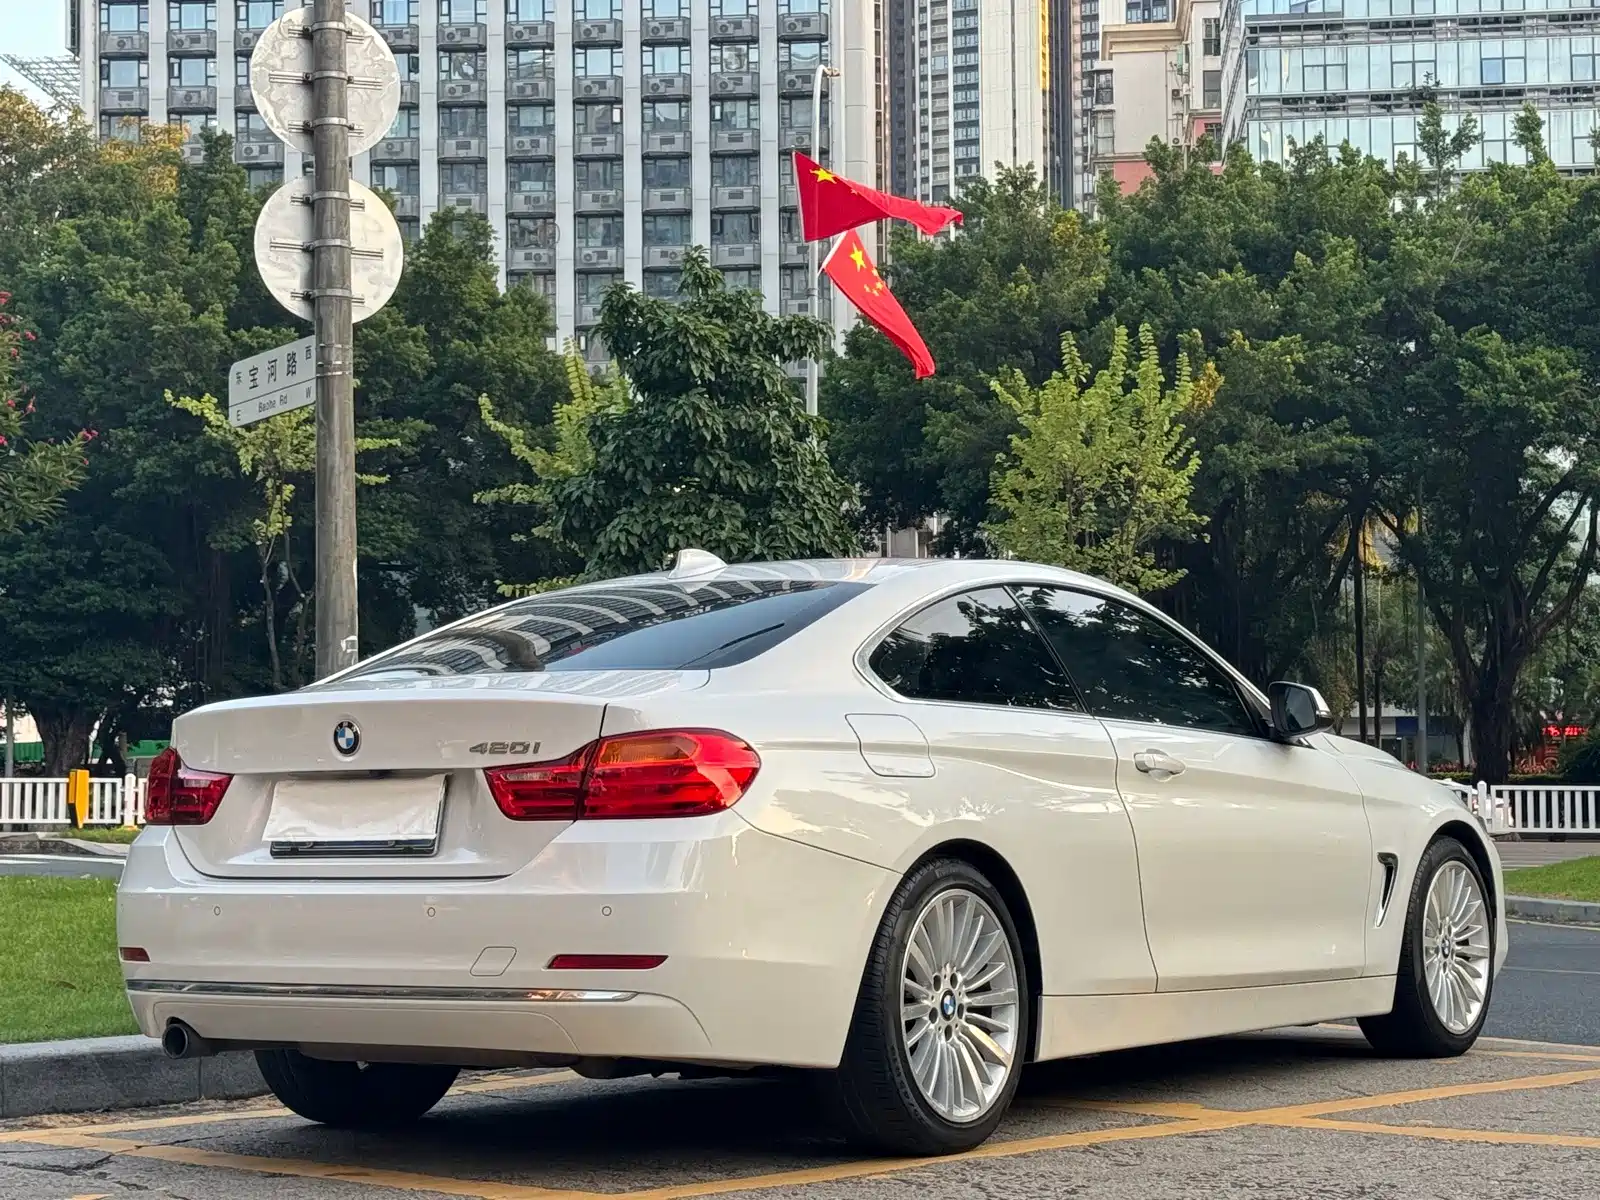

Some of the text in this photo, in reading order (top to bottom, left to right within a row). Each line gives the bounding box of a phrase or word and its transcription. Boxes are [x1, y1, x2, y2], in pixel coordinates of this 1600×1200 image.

[248, 351, 297, 390] 宝河路
[305, 345, 312, 360] 西
[236, 386, 312, 421] E Baohe Rd W
